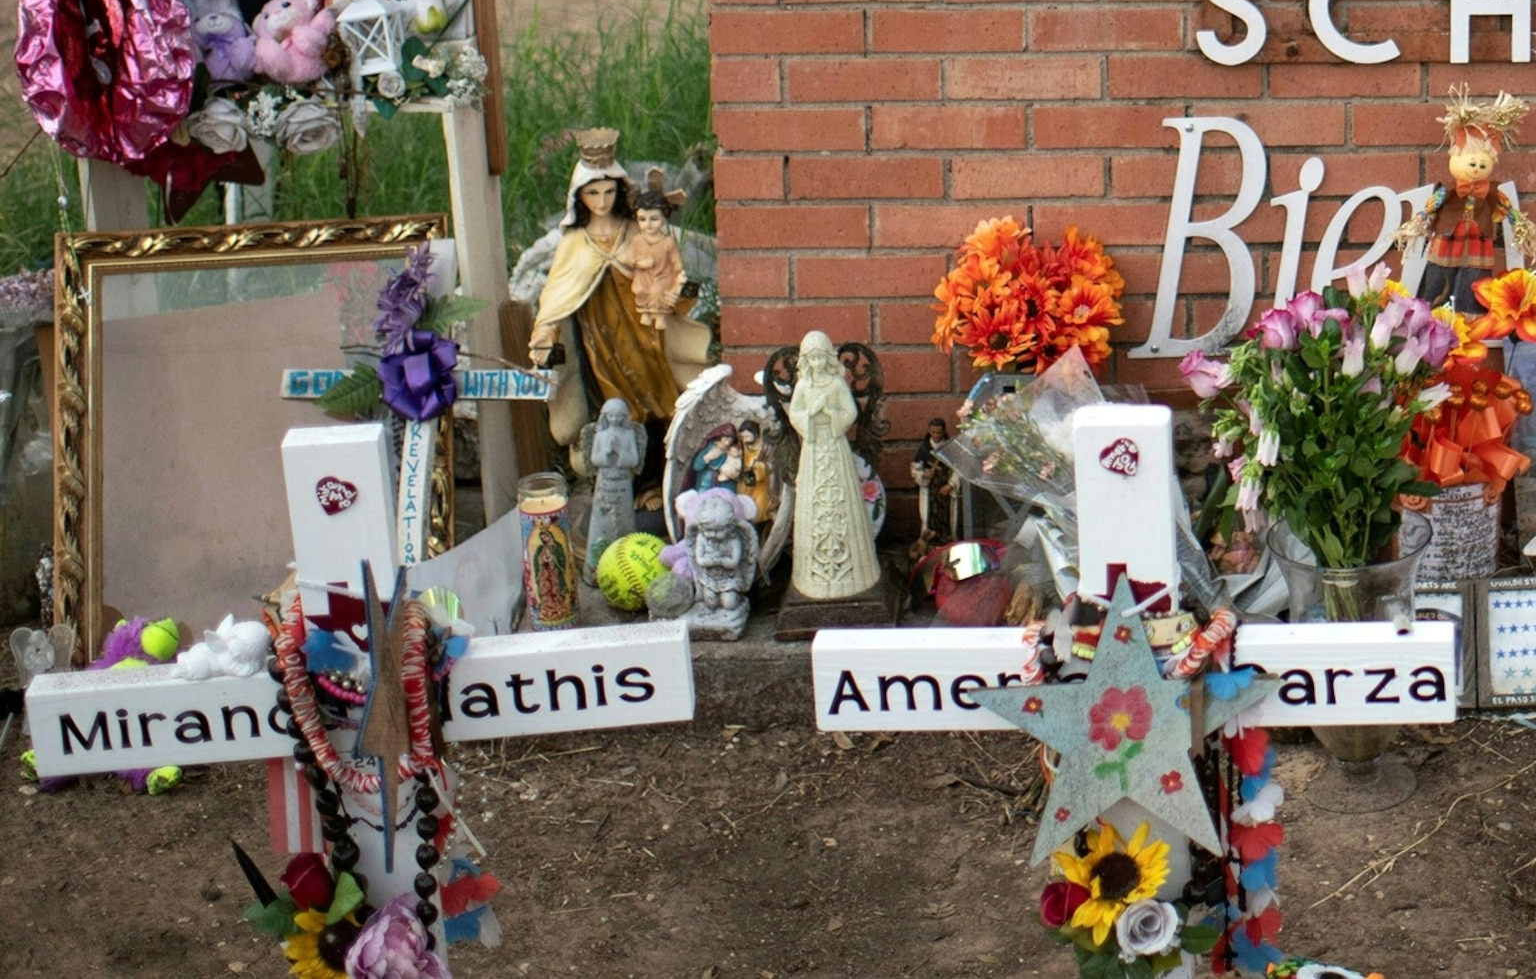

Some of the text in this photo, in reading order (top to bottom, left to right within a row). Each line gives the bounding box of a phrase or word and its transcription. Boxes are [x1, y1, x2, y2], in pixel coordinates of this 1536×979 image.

[464, 371, 508, 397] WITH
[512, 370, 550, 397] YOU
[403, 421, 422, 565] REVELATION
[1490, 579, 1523, 588] UVALDE
[1235, 663, 1447, 707] arza
[1492, 696, 1504, 705] EL
[1505, 695, 1529, 704] PASO
[60, 662, 656, 757] Miran athis
